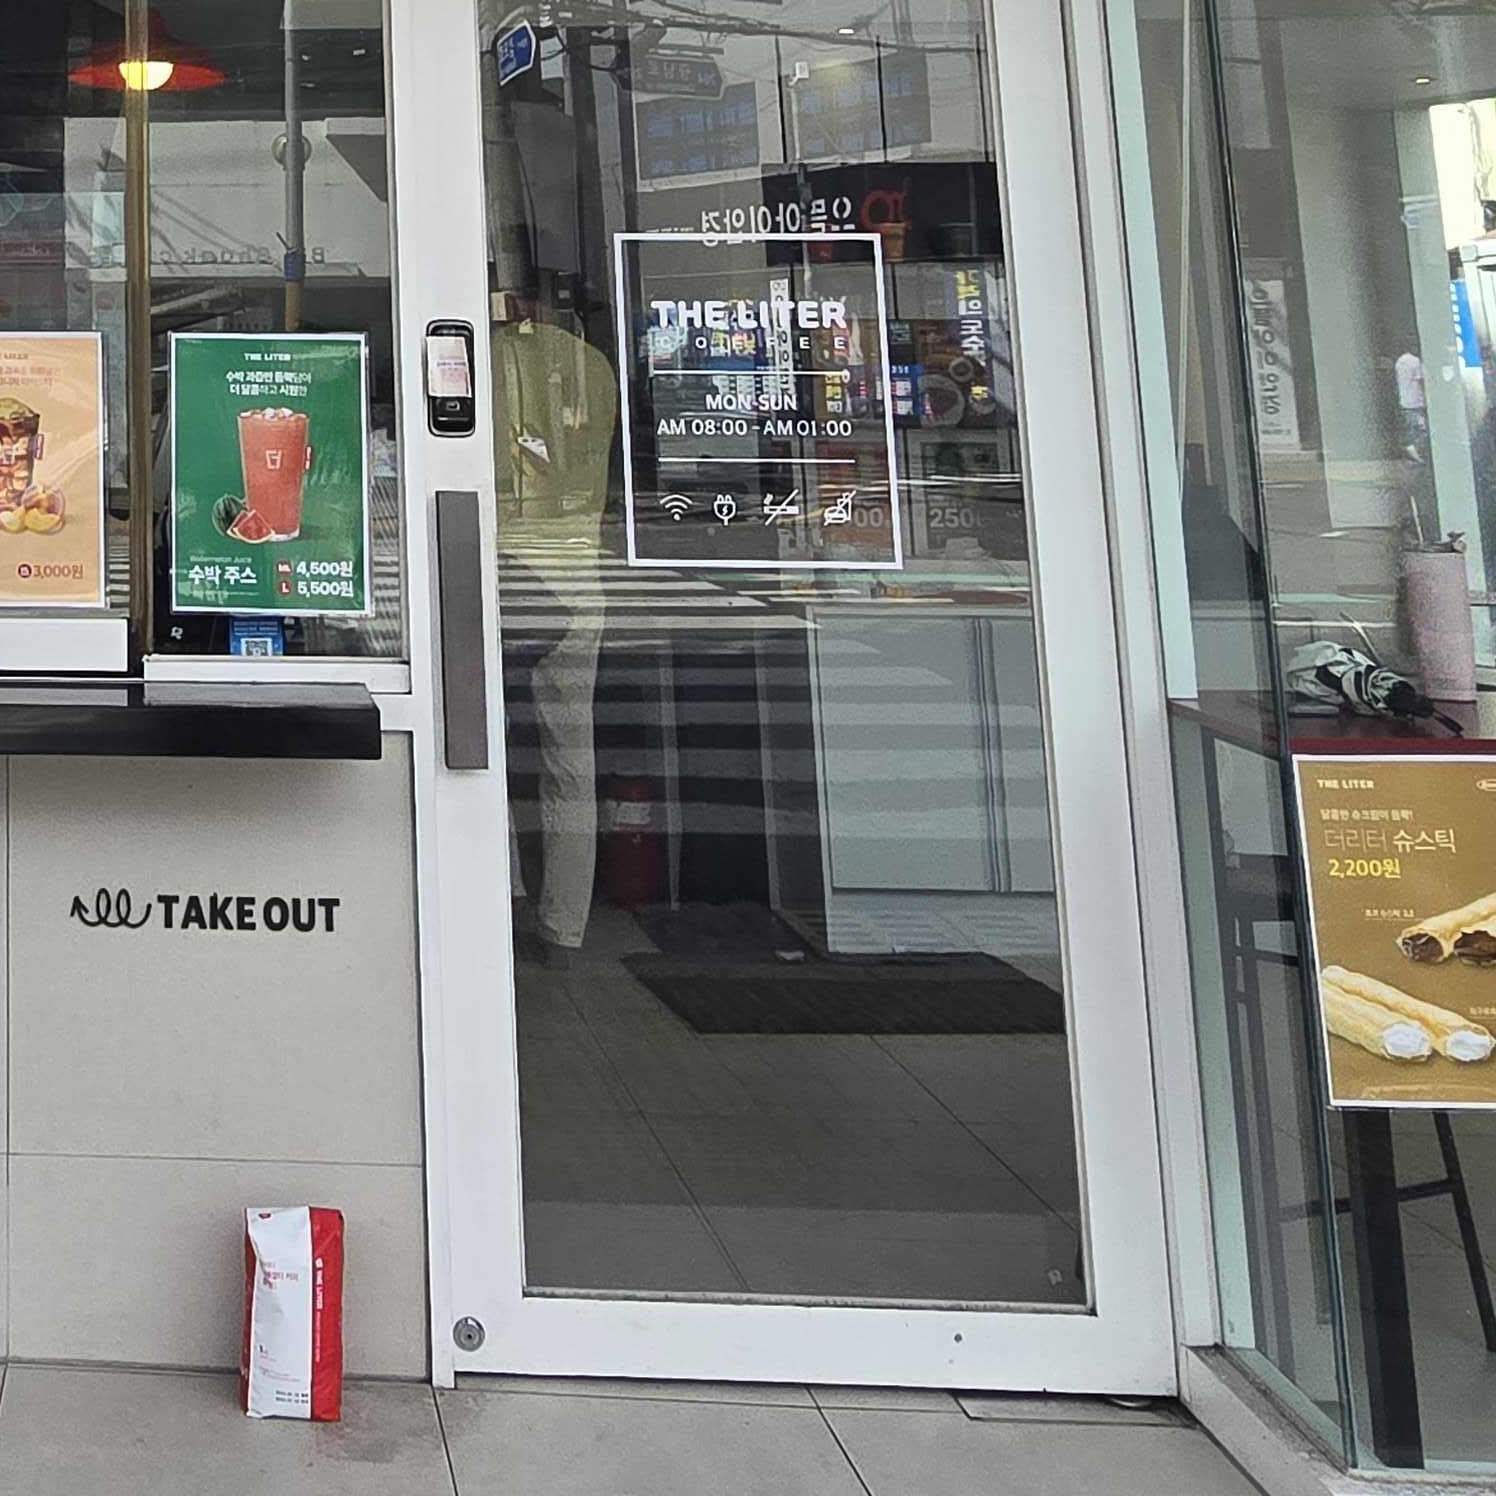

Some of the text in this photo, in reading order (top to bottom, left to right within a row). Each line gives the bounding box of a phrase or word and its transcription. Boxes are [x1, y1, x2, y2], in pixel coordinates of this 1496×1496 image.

[651, 300, 847, 329] THE LITER
[244, 353, 262, 361] THE
[657, 419, 686, 435] AM
[692, 419, 747, 435] 08:00
[764, 420, 792, 435] AM
[796, 420, 852, 436] 01:00
[34, 564, 84, 580] 3,000원
[188, 565, 257, 585] 수박 주스
[296, 561, 353, 578] 4,500원
[297, 580, 354, 598] 5,500원
[1317, 779, 1374, 789] THE LITER
[1324, 828, 1456, 853] 더리터 슈스틱
[1328, 858, 1401, 879] 2,200원
